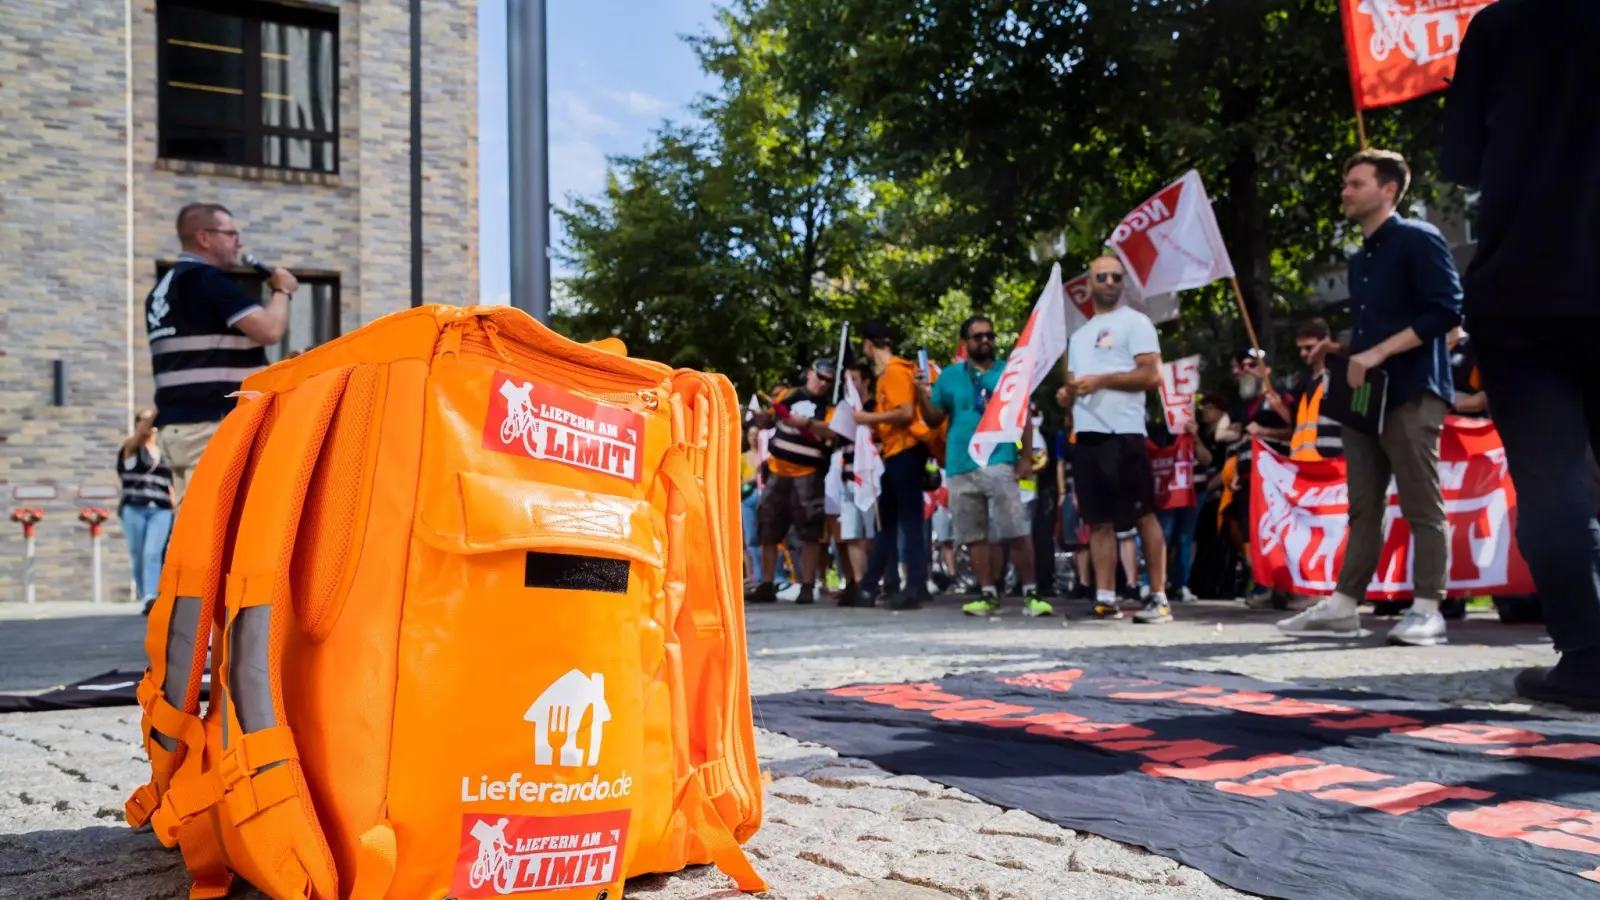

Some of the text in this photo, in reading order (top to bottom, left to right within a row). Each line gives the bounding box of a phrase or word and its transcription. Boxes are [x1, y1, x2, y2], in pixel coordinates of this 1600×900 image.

[540, 404, 618, 438] LIEFERN AM
[544, 426, 630, 475] LIMIT
[461, 770, 632, 803] Lieferando.de
[515, 832, 602, 853] LIEFERN AM
[513, 852, 611, 888] LIMIT
